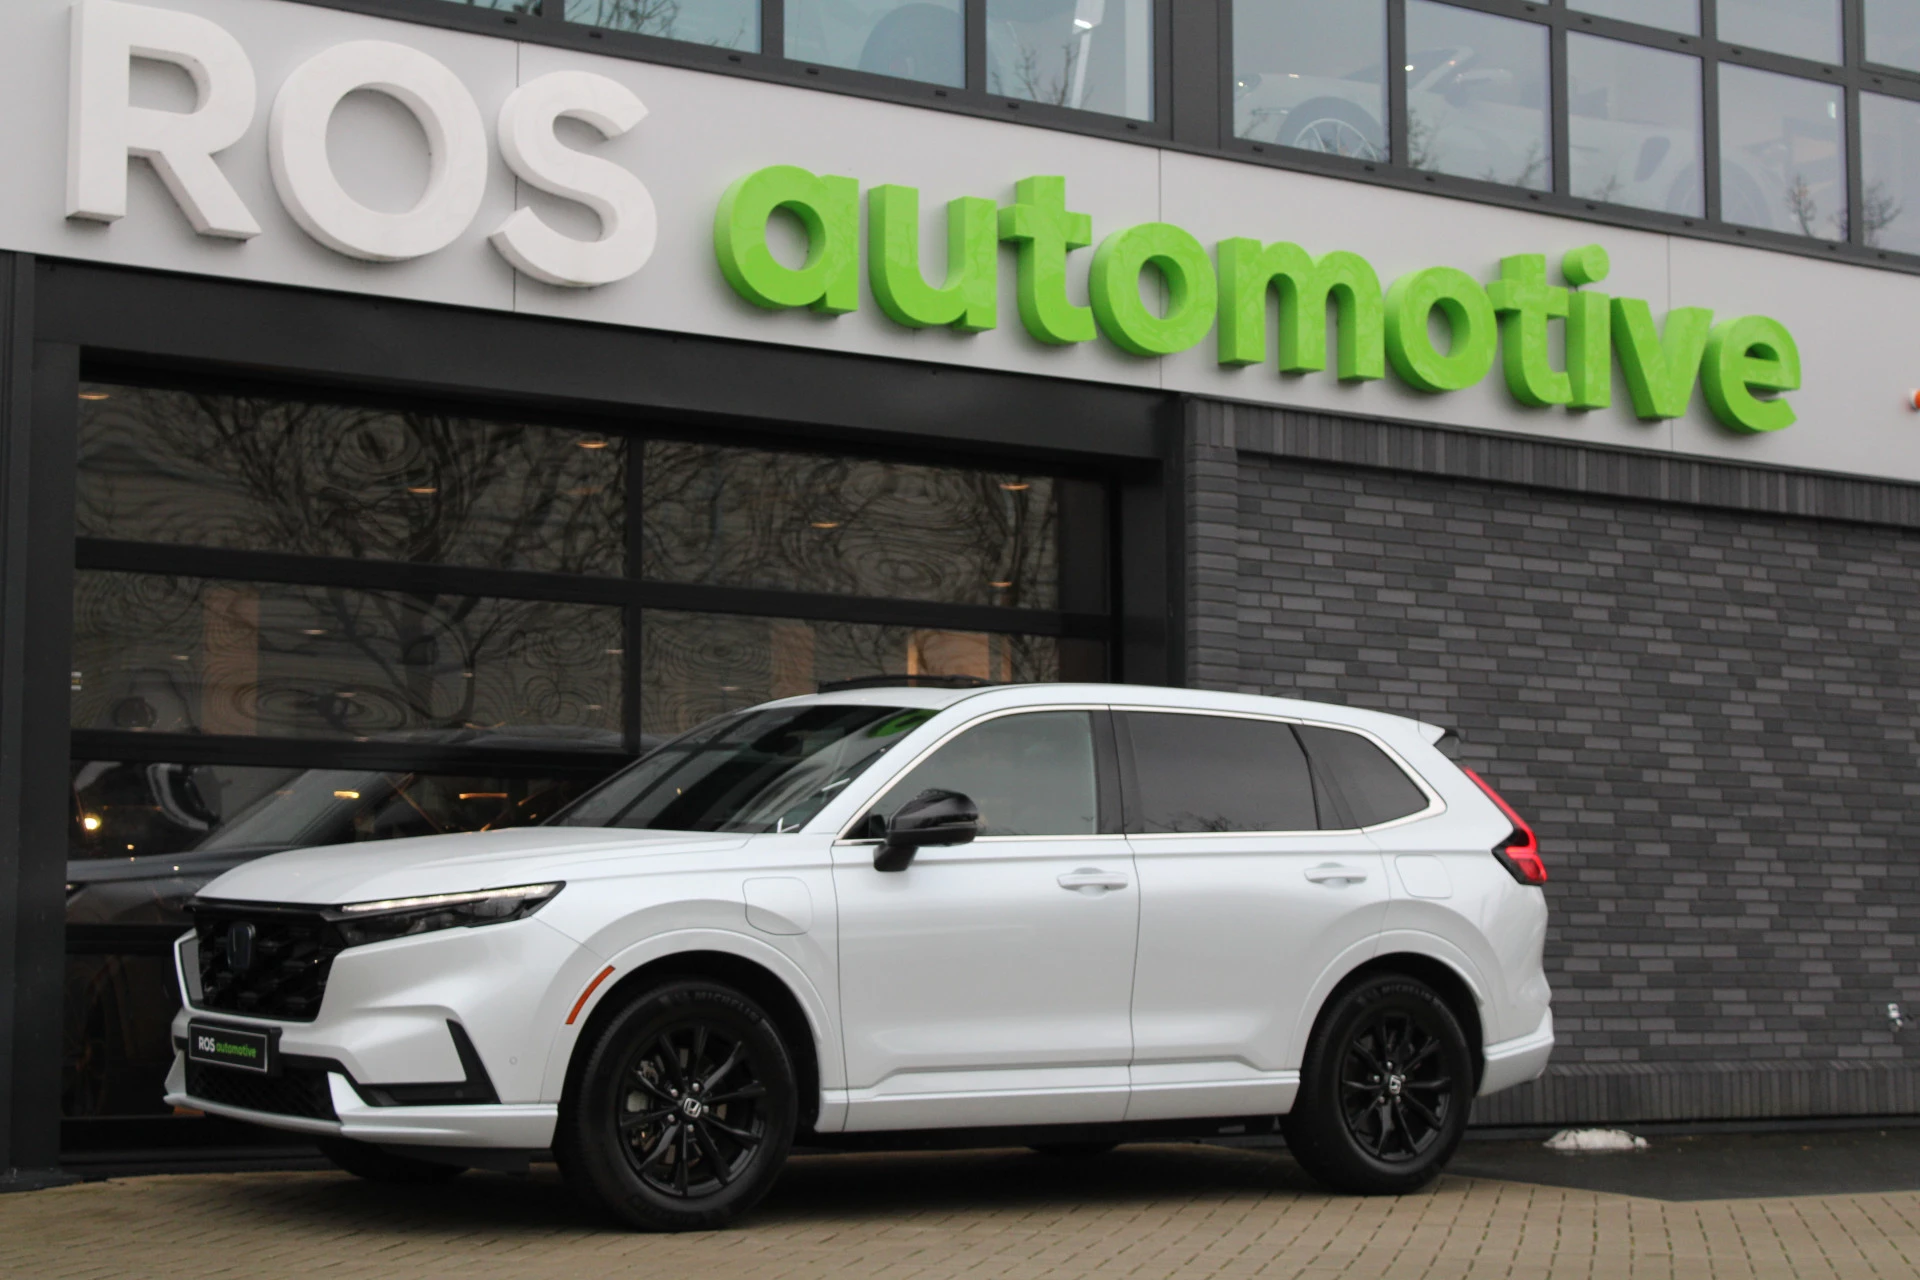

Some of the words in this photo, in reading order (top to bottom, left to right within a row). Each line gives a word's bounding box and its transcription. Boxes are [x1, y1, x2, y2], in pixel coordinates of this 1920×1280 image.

[65, 0, 659, 289] ROS
[713, 165, 1802, 433] automotive
[198, 1035, 216, 1053] ROS
[216, 1041, 257, 1058] automotive
